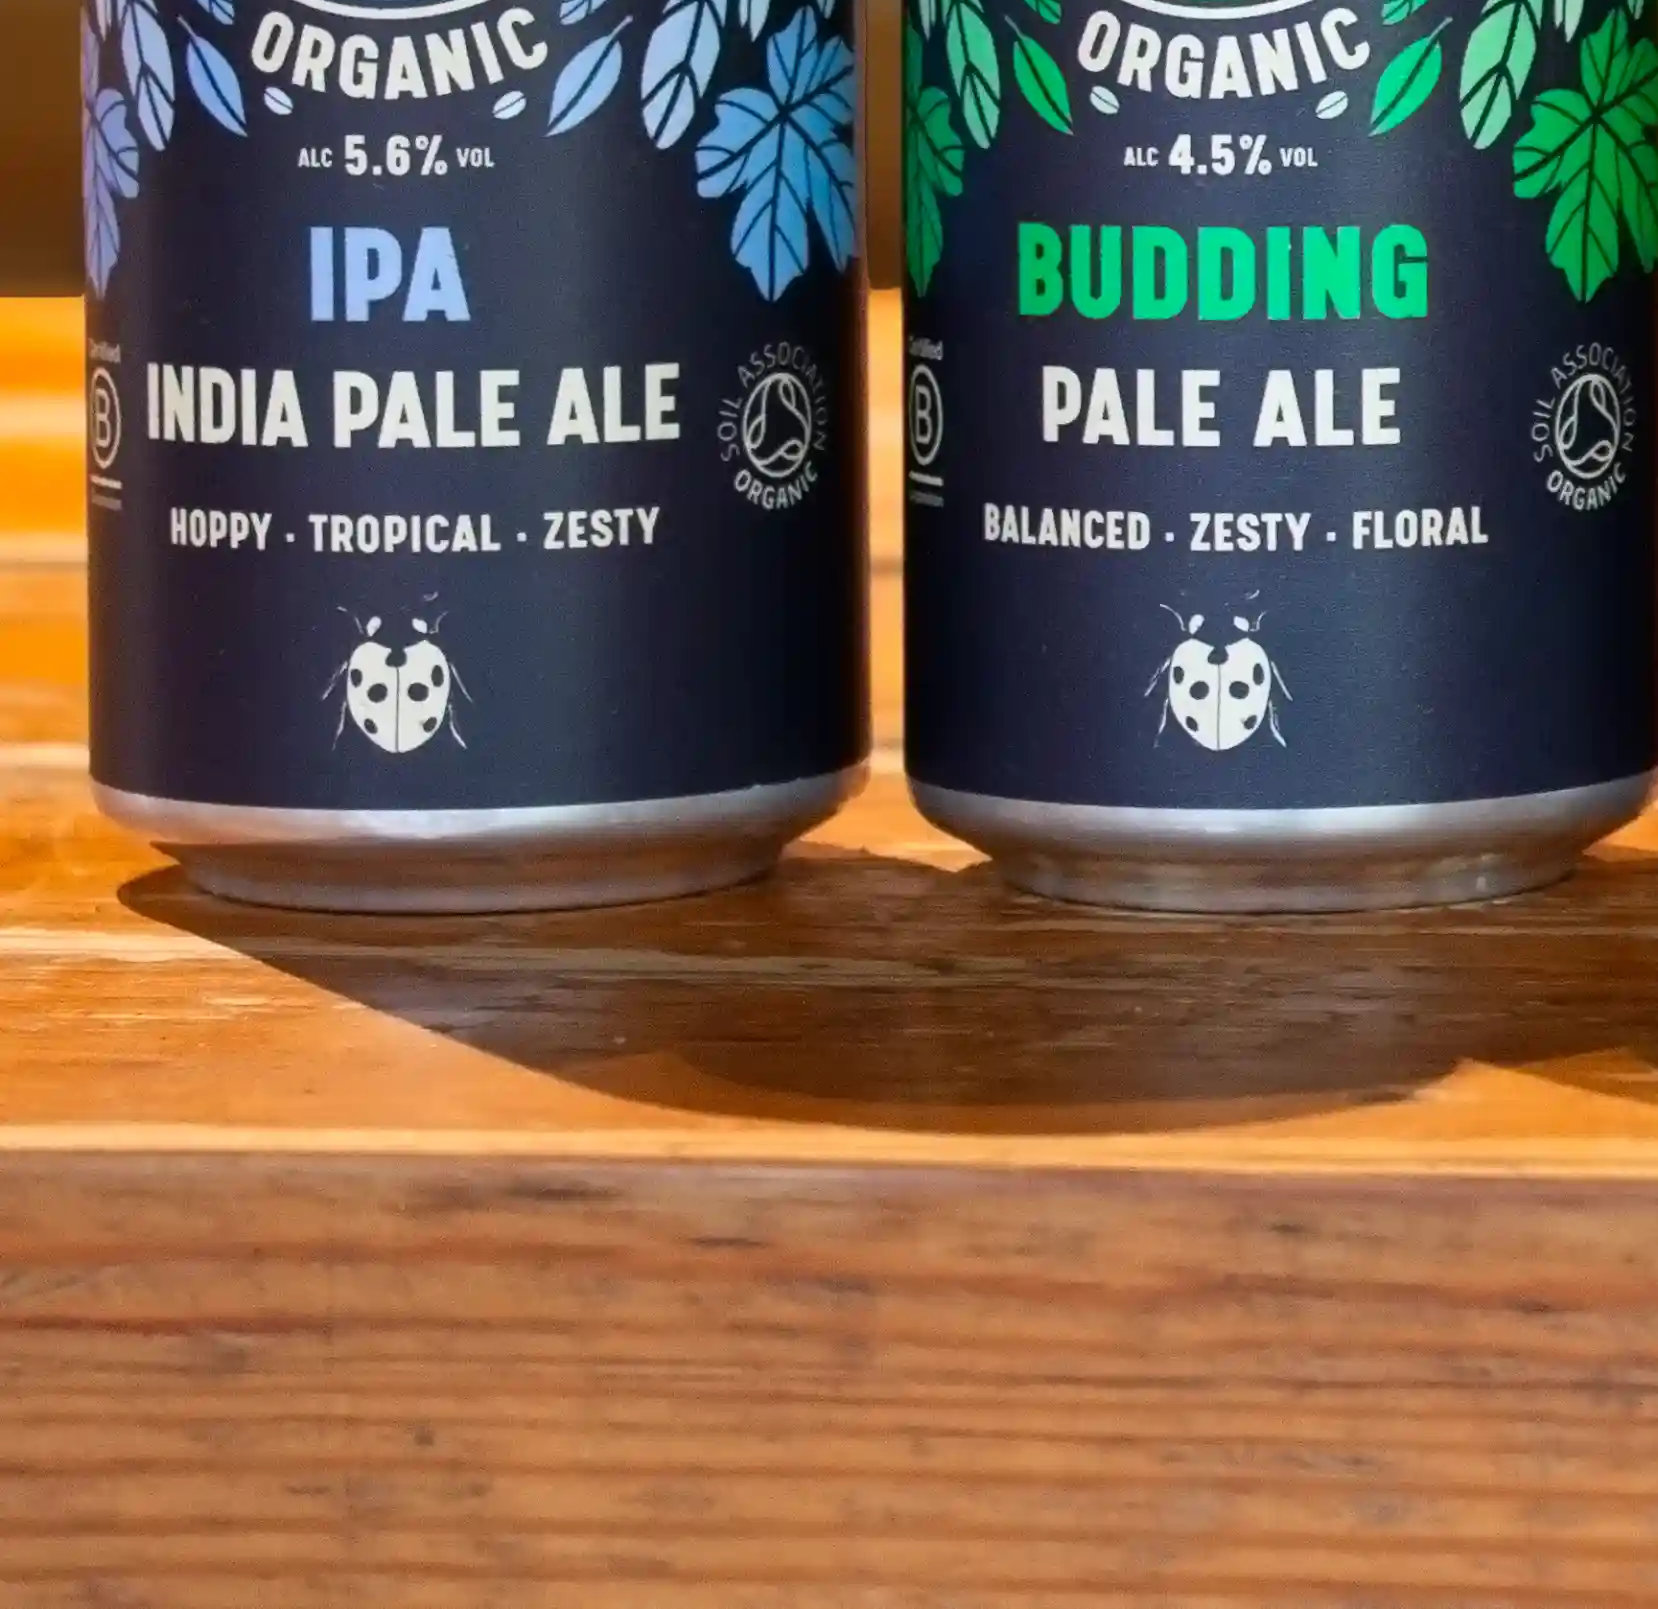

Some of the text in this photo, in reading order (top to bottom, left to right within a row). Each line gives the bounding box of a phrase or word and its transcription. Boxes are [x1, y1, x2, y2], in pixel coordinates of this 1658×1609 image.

[251, 7, 548, 101] ORGANIC
[1077, 7, 1371, 100] ORGANIC
[297, 134, 495, 176] ALC 5.6% VOL
[1123, 133, 1319, 176] ALC 4.5% VOL
[310, 226, 471, 322] IPA
[1019, 223, 1428, 321] BUDDING
[147, 362, 680, 449] INDIA PALE ALE
[717, 397, 743, 462] SOIL
[1042, 365, 1401, 447] PALE ALE
[1531, 342, 1636, 463] SOIL ASSOCIATION
[734, 460, 818, 511] ORGANIC
[1546, 462, 1627, 512] ORGANIC
[170, 506, 660, 554] HOPPY TROPICAL ZESTY
[984, 502, 1489, 552] BALANCED ZESTY FLORAL
